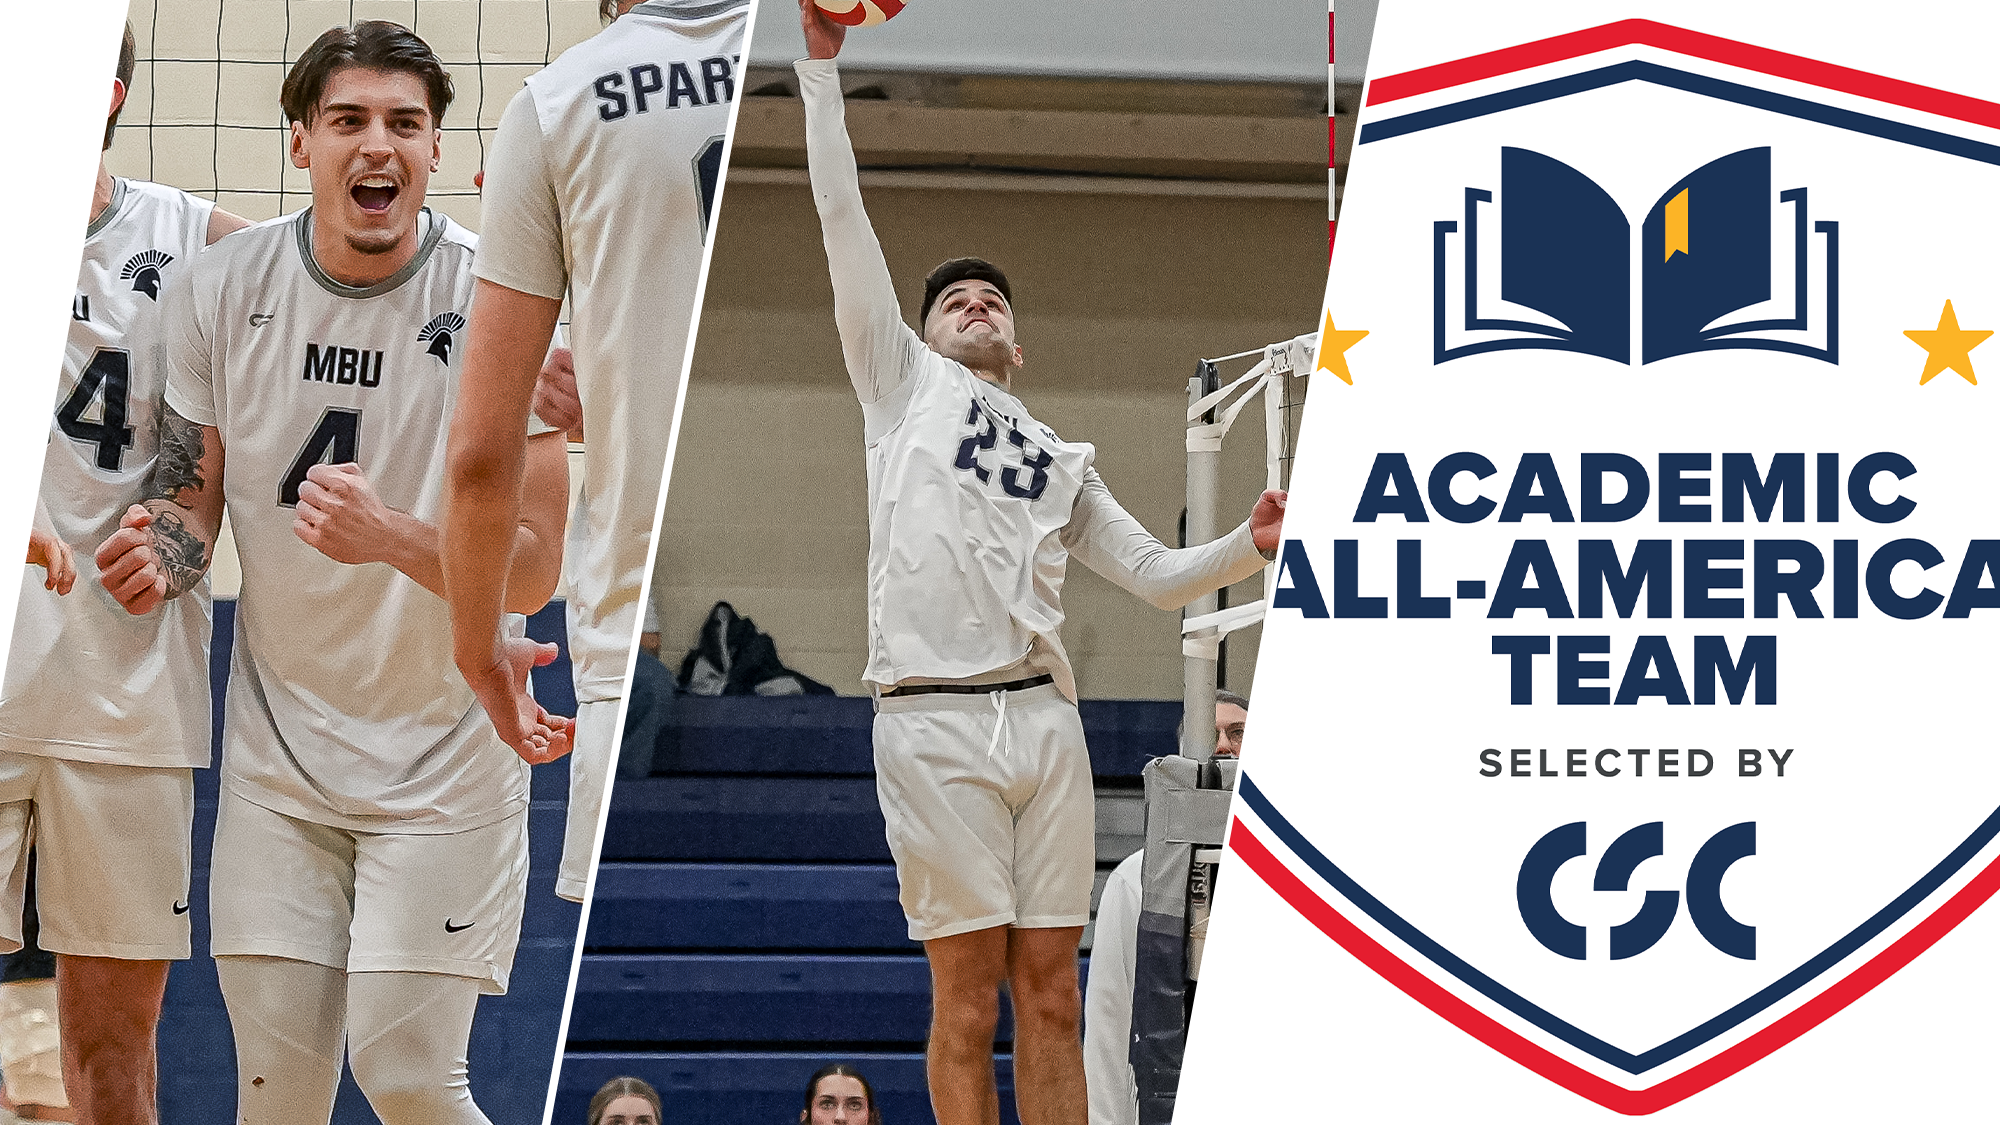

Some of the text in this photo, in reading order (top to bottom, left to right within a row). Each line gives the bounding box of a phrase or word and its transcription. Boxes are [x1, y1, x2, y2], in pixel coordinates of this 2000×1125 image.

[593, 54, 741, 123] SPAR
[303, 342, 384, 388] MBU
[53, 346, 137, 474] 4
[951, 397, 1055, 502] 23
